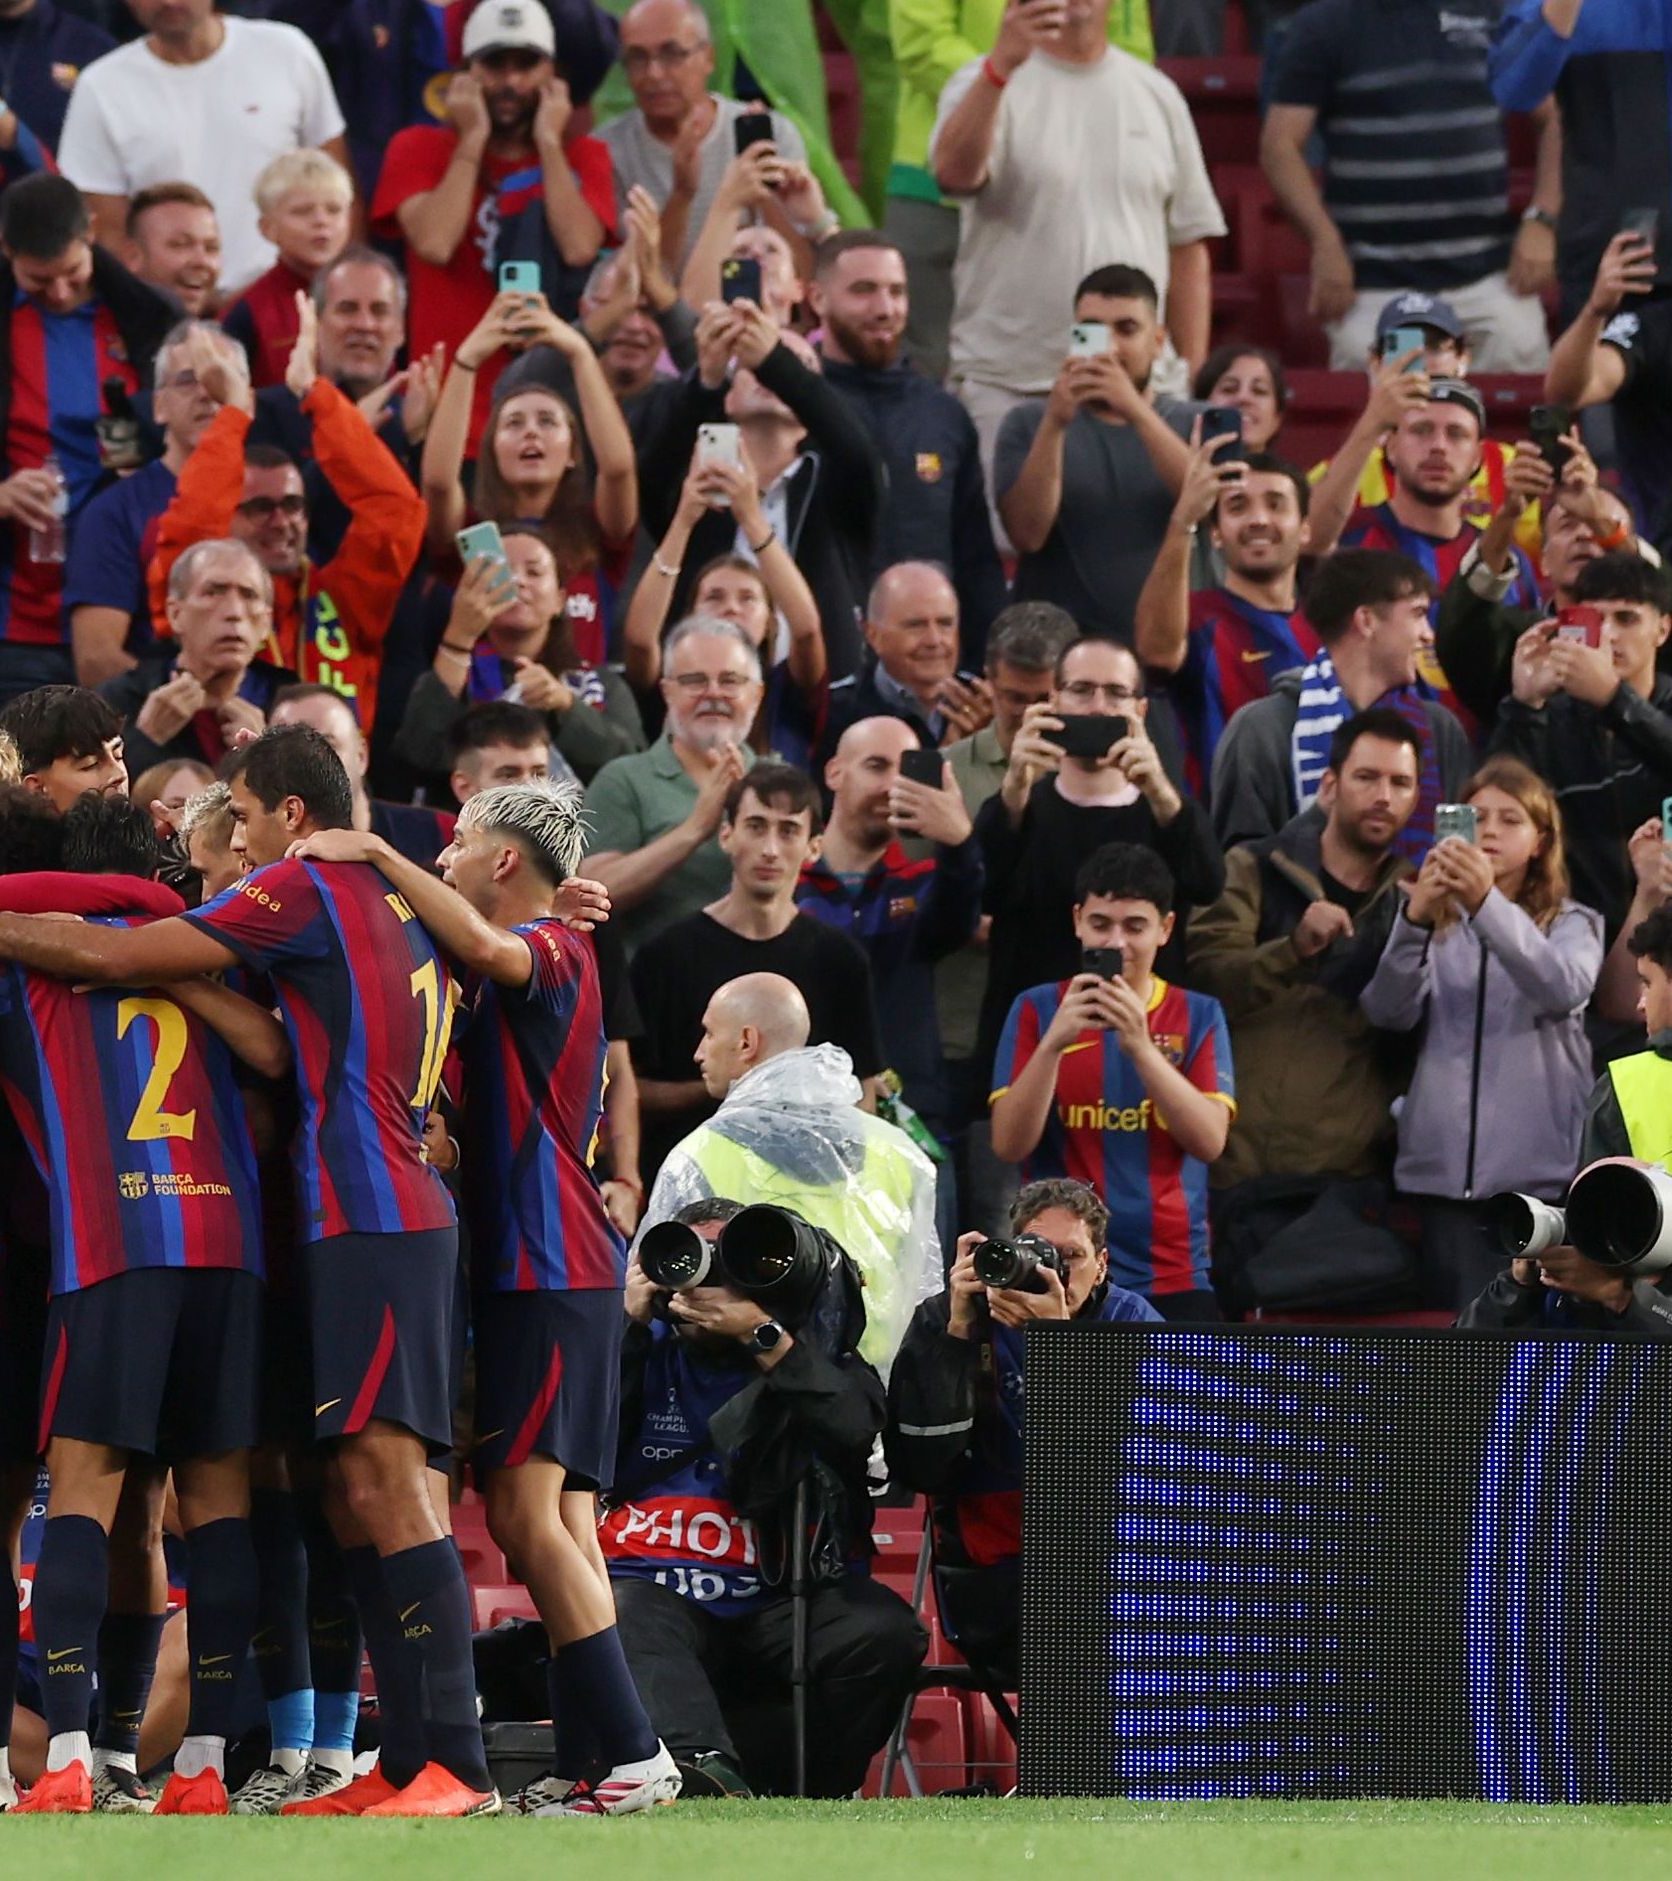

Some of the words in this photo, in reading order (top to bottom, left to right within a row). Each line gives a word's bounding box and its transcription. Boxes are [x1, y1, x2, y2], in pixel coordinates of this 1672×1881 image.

[117, 997, 196, 1141] 2
[1058, 1098, 1151, 1132] unicef
[154, 1184, 232, 1197] FOUNDATION
[615, 1505, 756, 1566] PHOT
[47, 1664, 86, 1676] BARÇA
